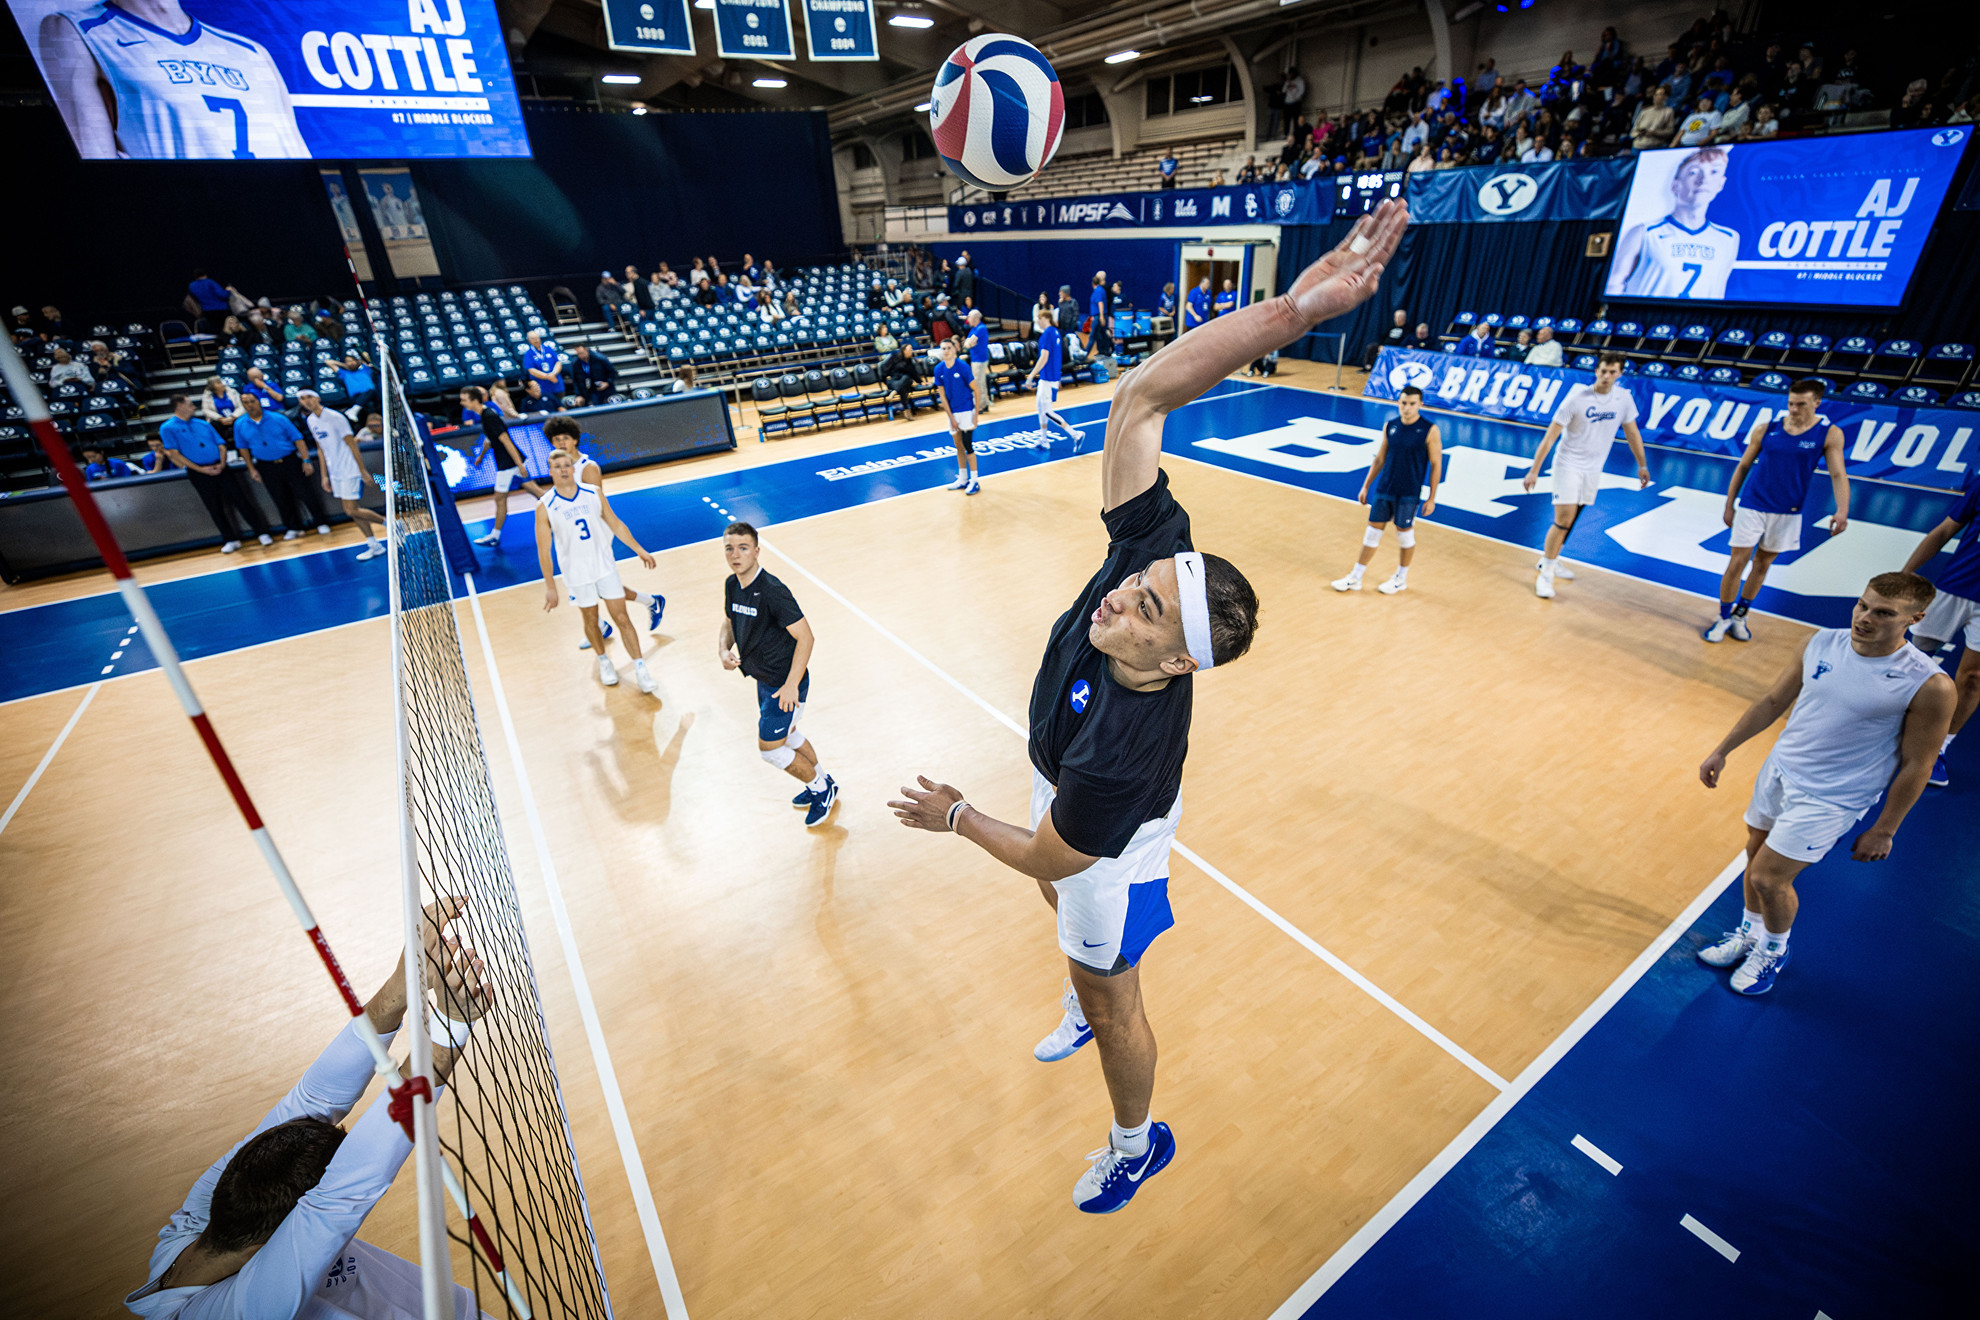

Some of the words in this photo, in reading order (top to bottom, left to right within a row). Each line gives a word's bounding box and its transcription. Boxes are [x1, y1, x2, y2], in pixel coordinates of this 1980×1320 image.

[408, 0, 466, 37] AJ
[157, 59, 249, 91] BYU
[301, 30, 484, 93] COTTLE
[201, 94, 256, 159] 7
[413, 113, 450, 125] MIDDLE
[451, 113, 494, 125] BLOCKER
[1058, 202, 1111, 223] MPSF
[1211, 195, 1231, 218] M
[1855, 177, 1920, 218] AJ
[1758, 220, 1902, 258] COTTLE
[1678, 262, 1702, 299] 7
[1437, 366, 1590, 415] BRIGH
[1850, 419, 1973, 473] VOL
[816, 456, 917, 480] Elaine
[575, 518, 591, 540] 3
